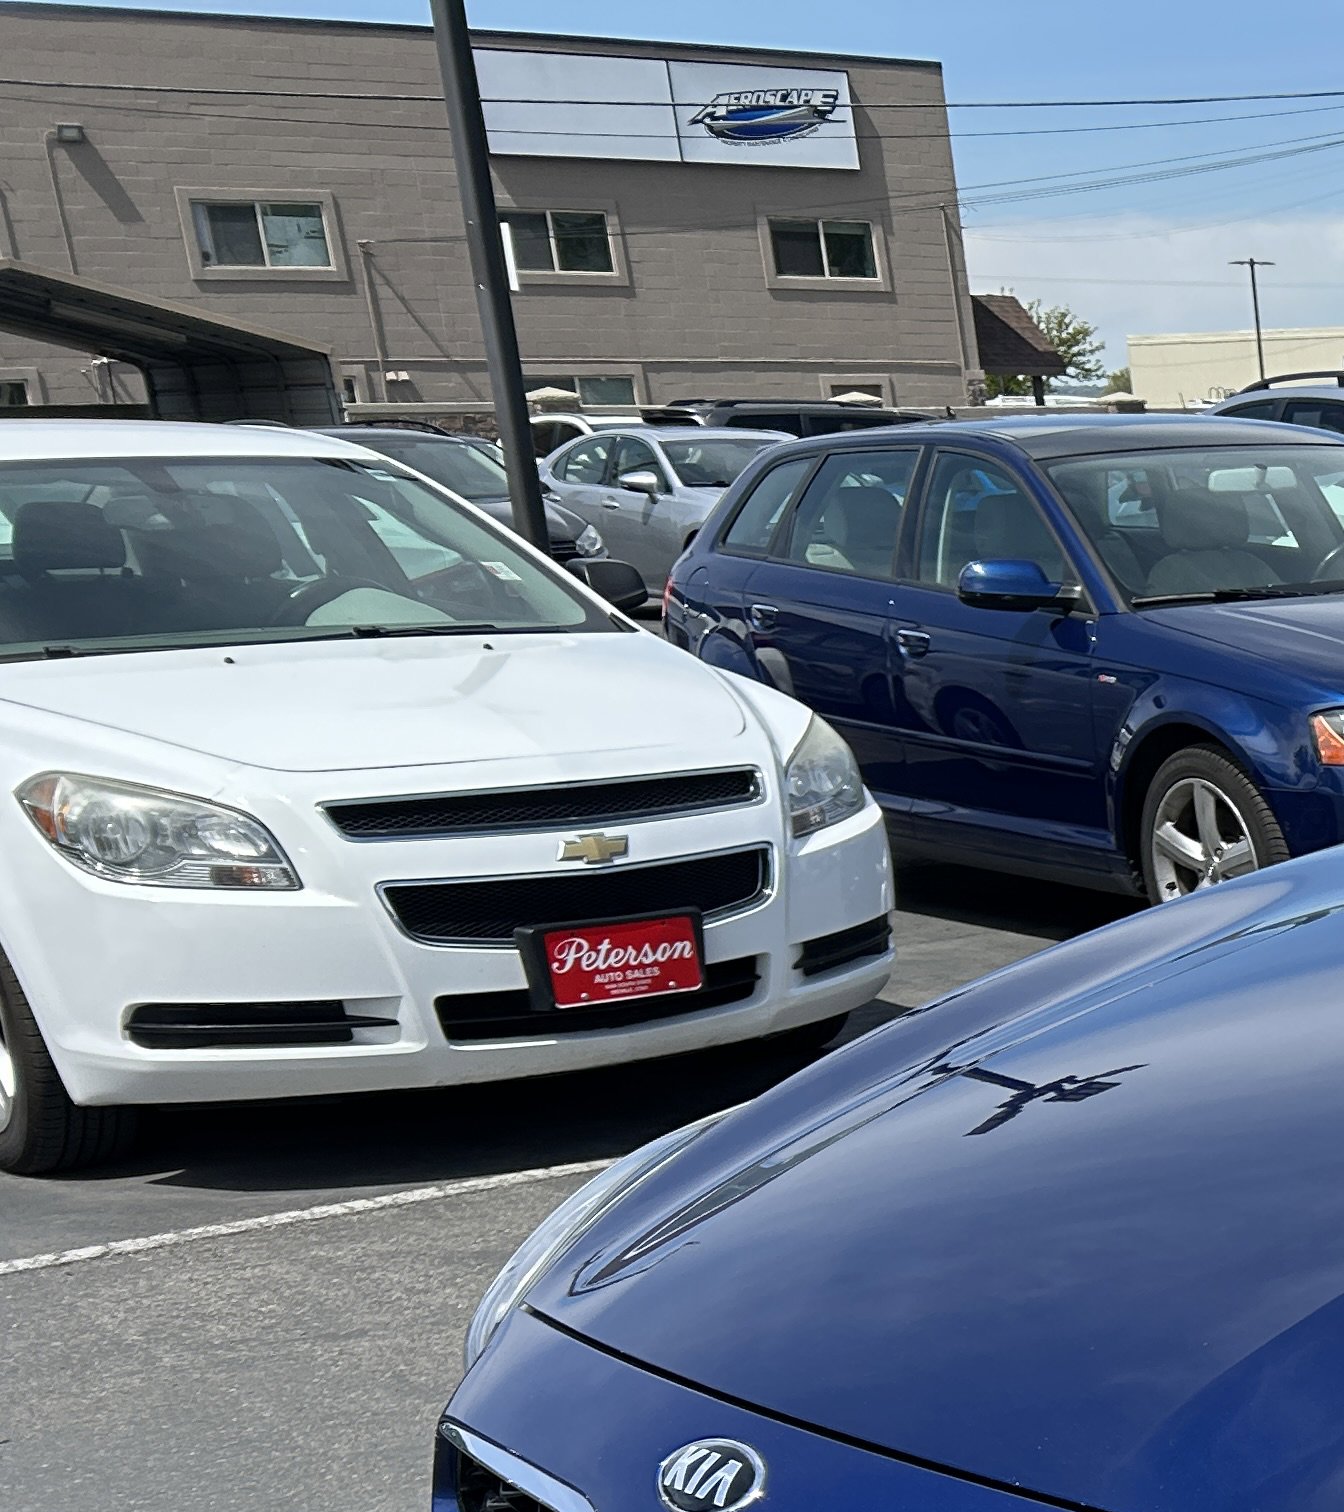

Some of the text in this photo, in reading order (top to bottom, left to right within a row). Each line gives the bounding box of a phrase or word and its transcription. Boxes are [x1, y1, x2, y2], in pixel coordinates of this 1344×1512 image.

[687, 89, 838, 125] AEROSCAPE
[552, 937, 694, 974] Peterson
[594, 967, 661, 983] AUTO SALES
[663, 1446, 743, 1507] KIA
